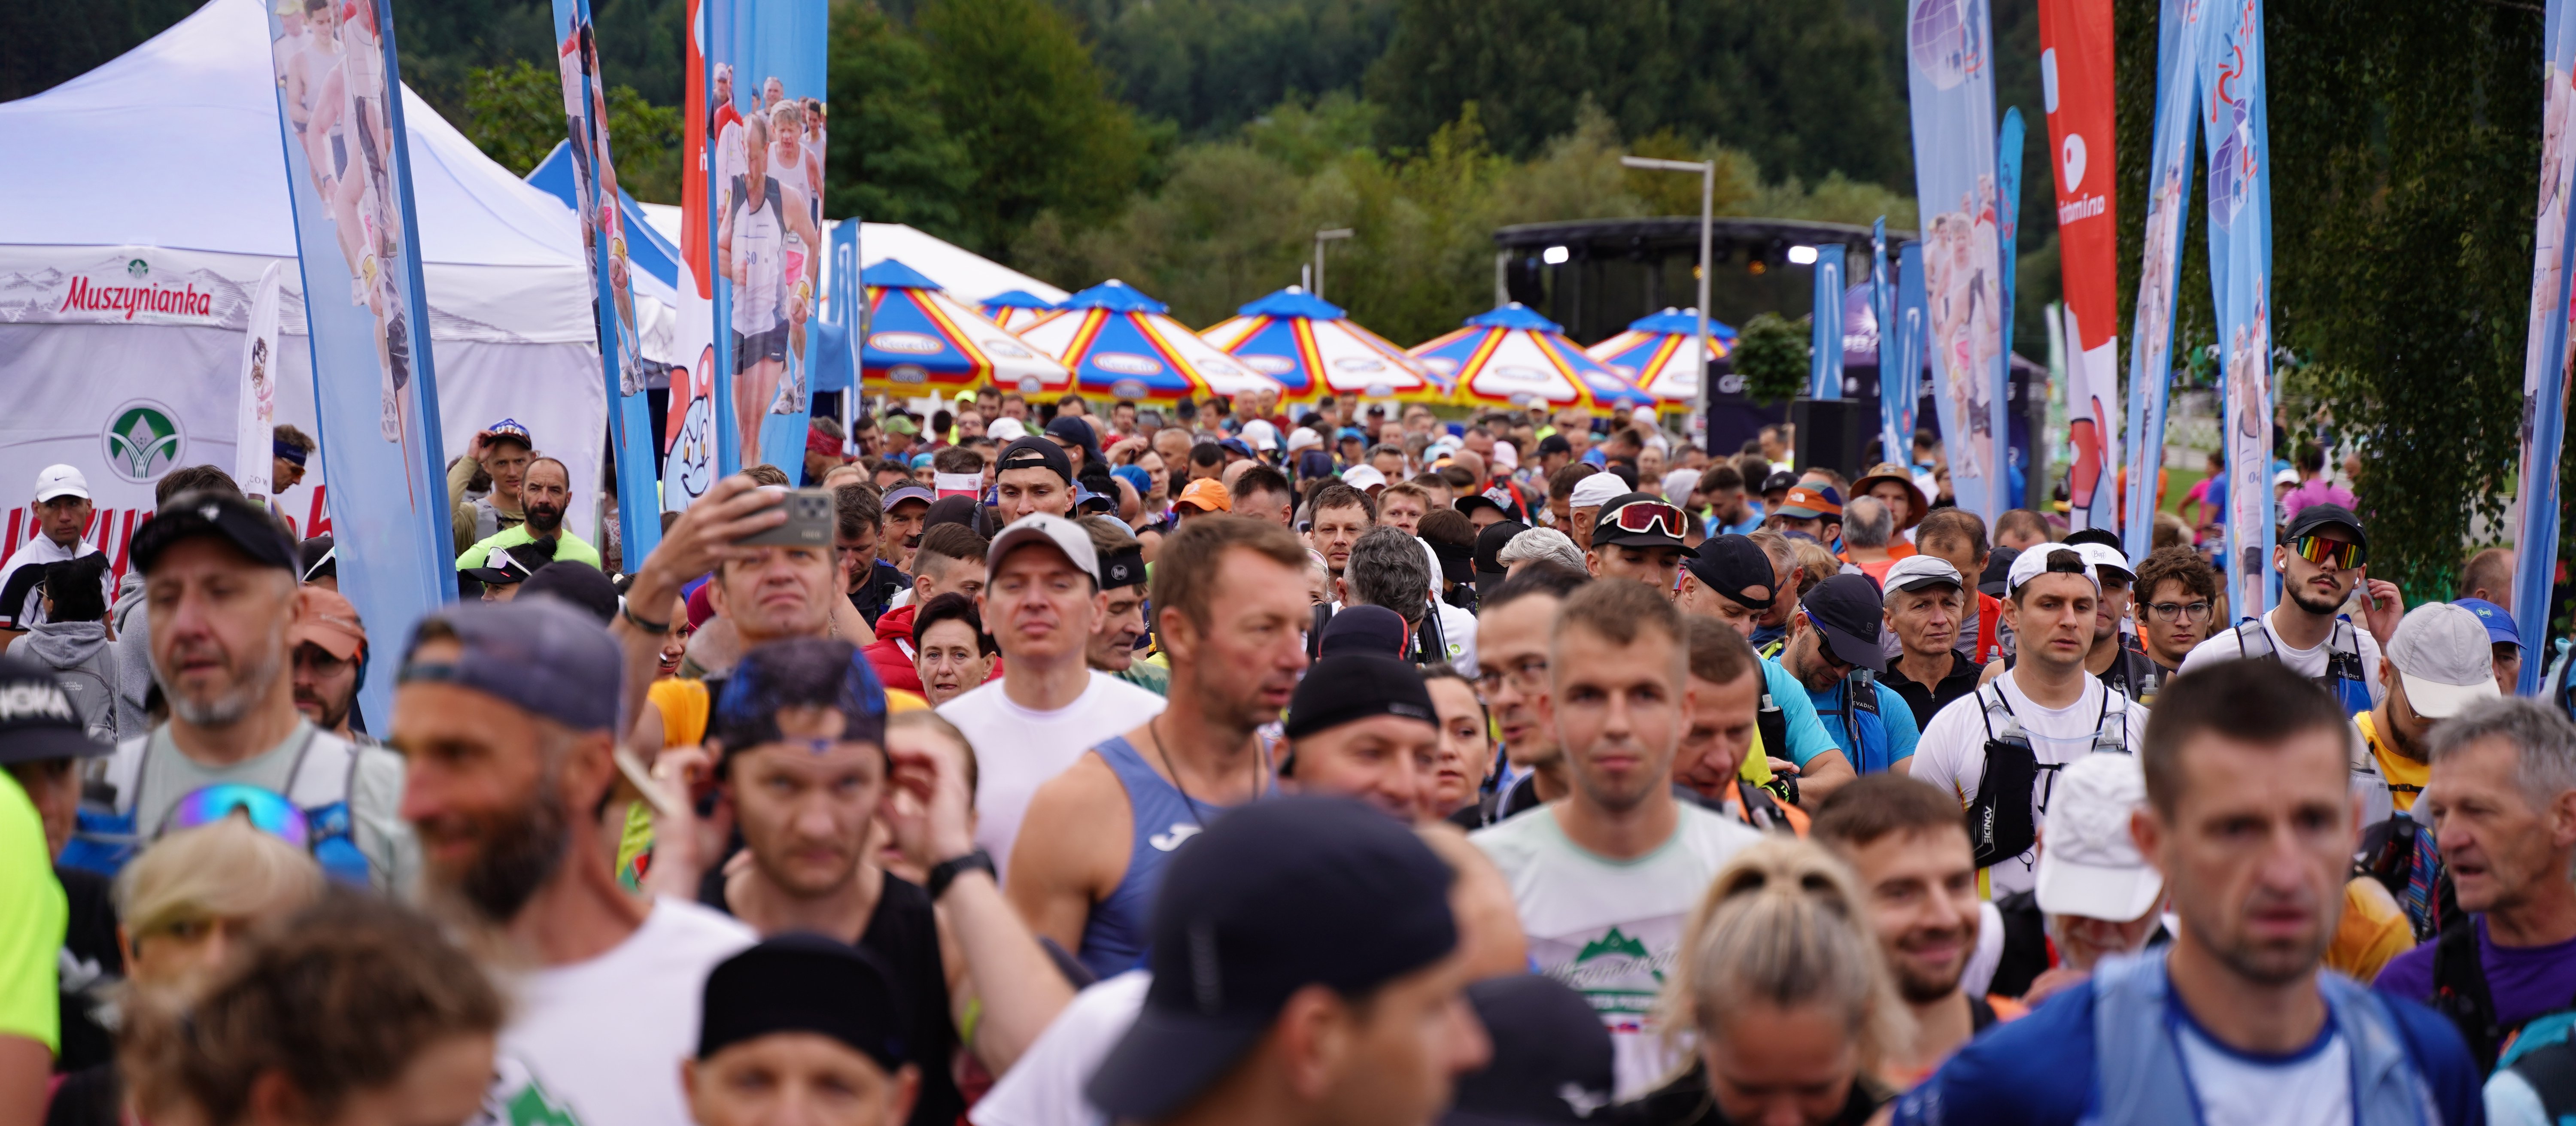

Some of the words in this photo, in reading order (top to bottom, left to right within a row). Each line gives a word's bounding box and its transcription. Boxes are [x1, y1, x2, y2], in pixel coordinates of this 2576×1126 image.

[58, 275, 212, 320] Muszynianka
[497, 425, 522, 436] UTA
[2093, 550, 2105, 558] Buff
[1114, 568, 1125, 578] Buff
[1853, 701, 1875, 711] EVADICT
